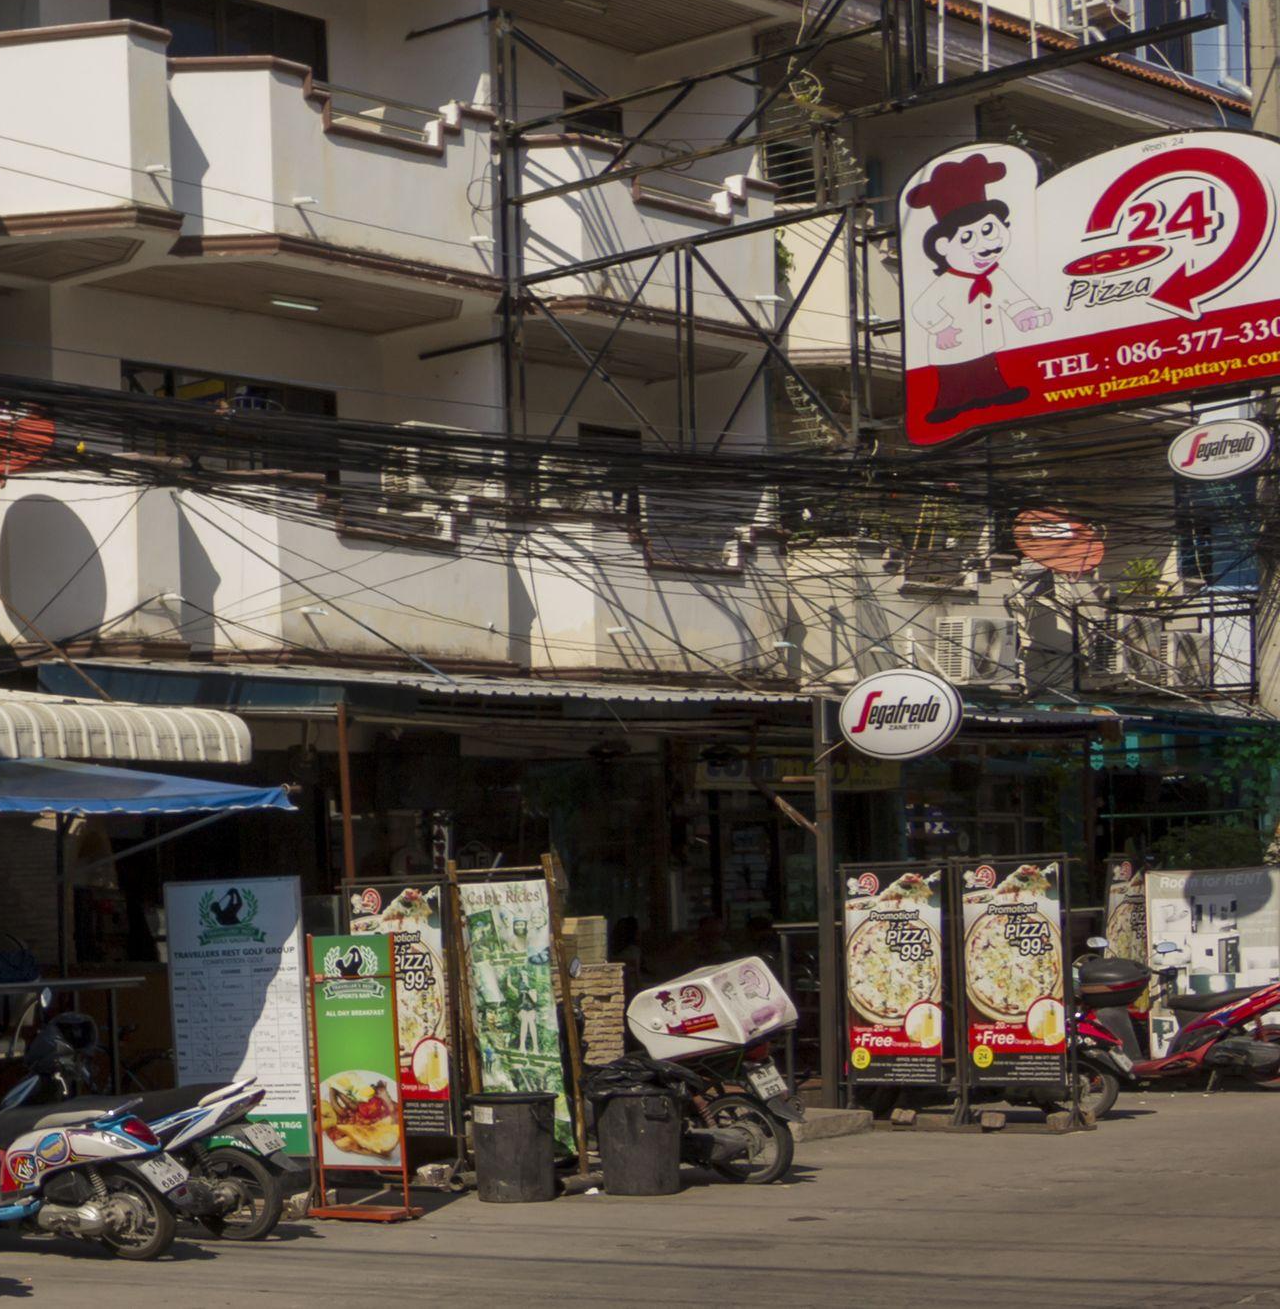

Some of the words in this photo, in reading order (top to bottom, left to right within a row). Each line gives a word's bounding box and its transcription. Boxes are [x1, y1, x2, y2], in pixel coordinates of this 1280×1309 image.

[1127, 189, 1216, 243] 24
[1064, 276, 1152, 311] Pizza
[1038, 353, 1099, 380] TEL
[1180, 431, 1256, 467] Segafredo
[851, 690, 940, 733] Segafredo
[1159, 876, 1198, 889] Room
[1202, 875, 1221, 888] for
[1225, 873, 1263, 886] RENT
[467, 889, 501, 905] Cable
[506, 888, 540, 903] Rides
[870, 910, 920, 922] Promotion!
[987, 902, 1037, 915] Promotion!
[886, 929, 931, 945] PIZZA
[1005, 922, 1050, 938] PIZZA
[174, 951, 220, 960] TRAVELLERS
[242, 948, 262, 956] GOLF
[265, 946, 295, 955] GROUP
[854, 1033, 893, 1047] +Free
[975, 1030, 1016, 1045] +Free
